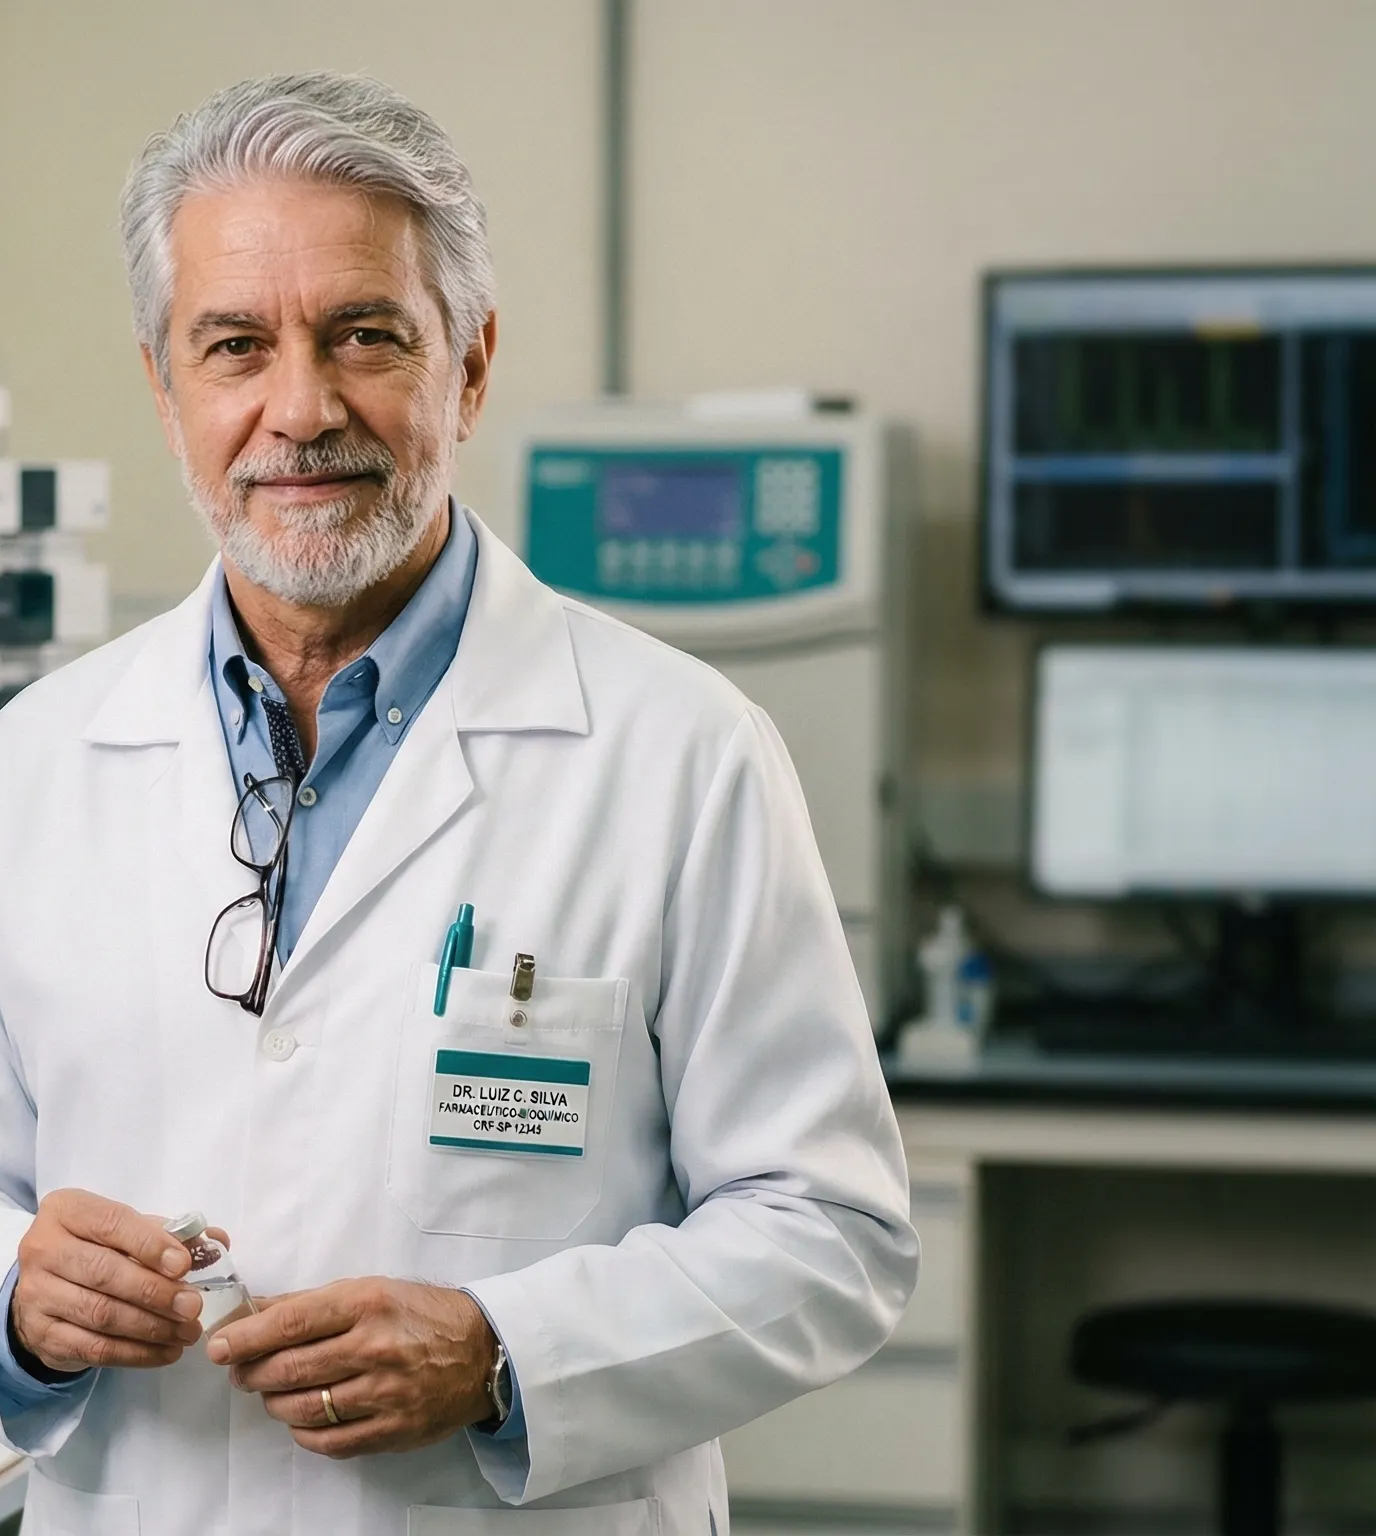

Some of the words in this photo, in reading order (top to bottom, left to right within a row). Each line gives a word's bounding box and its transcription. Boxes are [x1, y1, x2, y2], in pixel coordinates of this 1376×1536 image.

[453, 1084, 476, 1099] DR.
[479, 1087, 510, 1102] LUIZ
[513, 1089, 527, 1103] C.
[530, 1091, 568, 1107] SILVA
